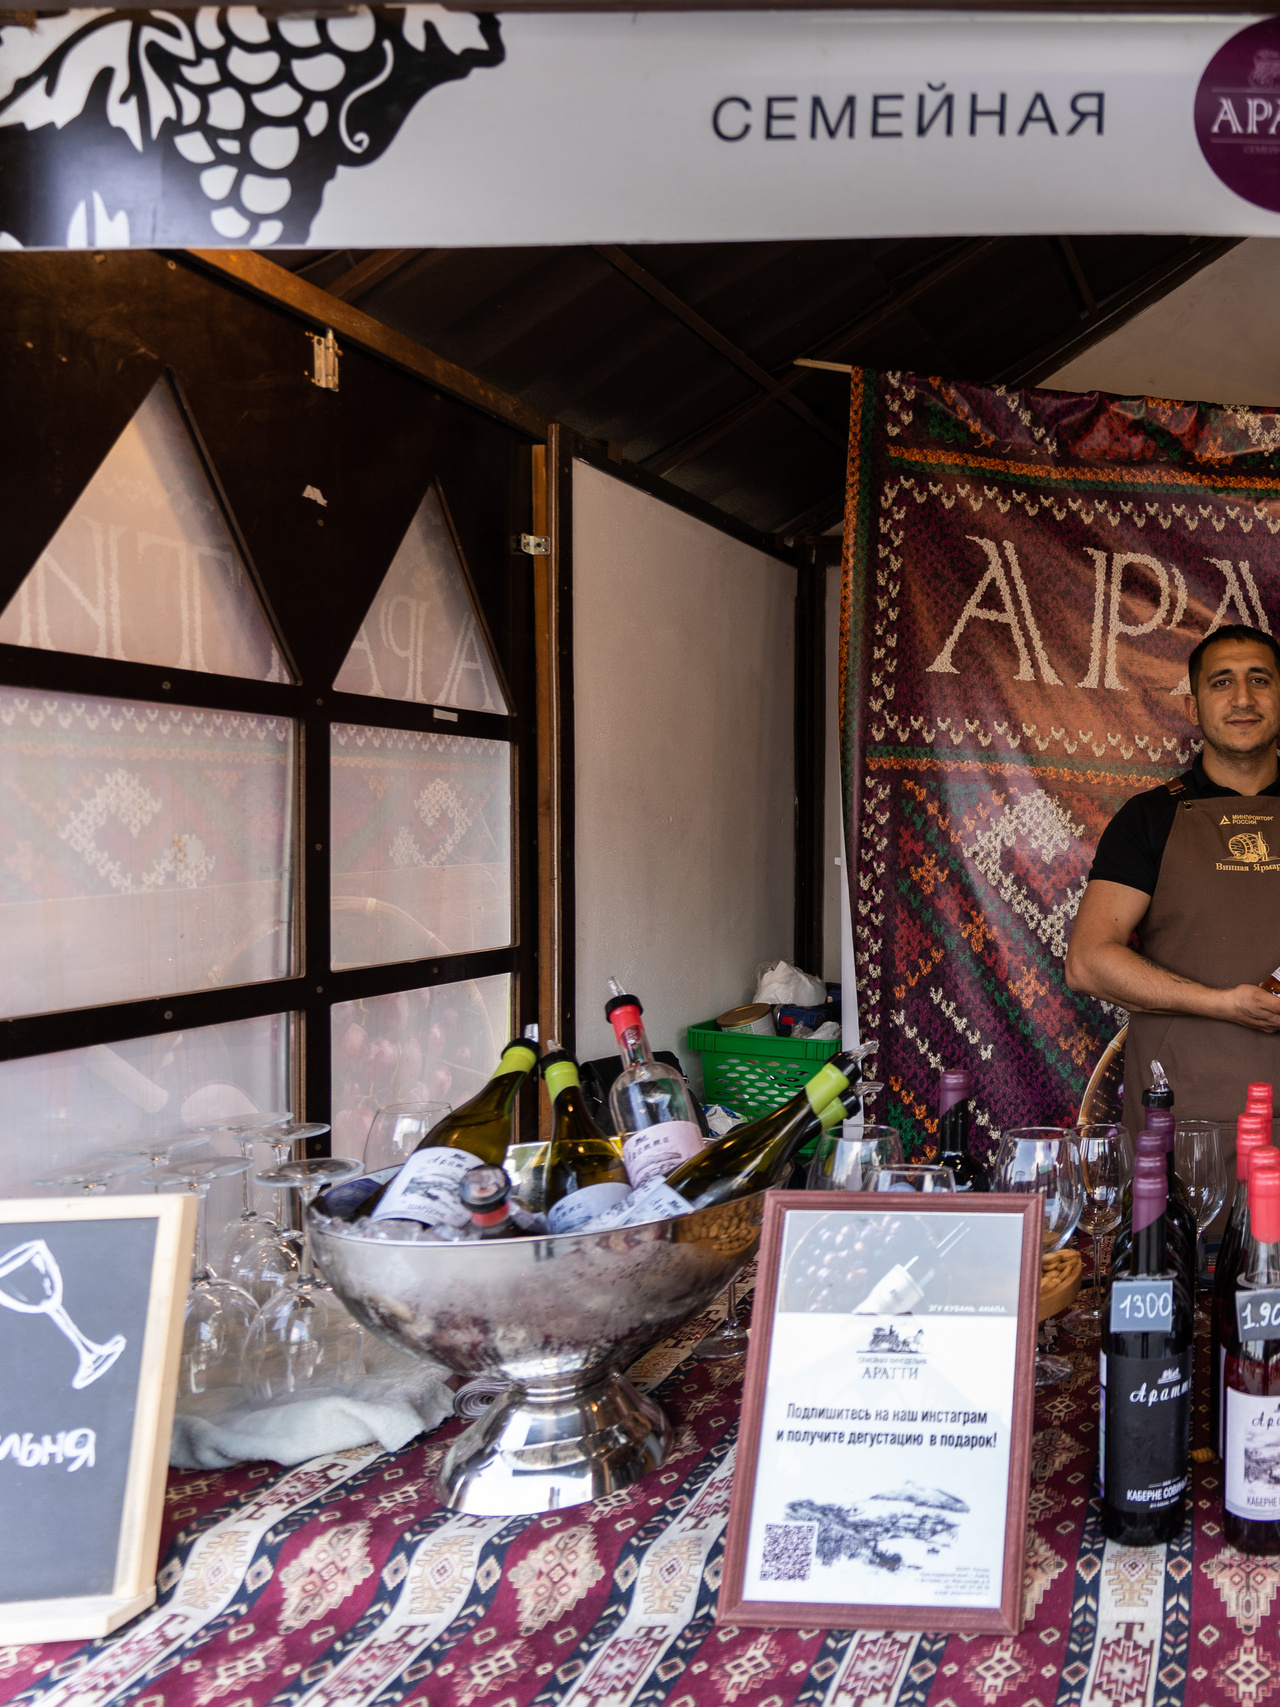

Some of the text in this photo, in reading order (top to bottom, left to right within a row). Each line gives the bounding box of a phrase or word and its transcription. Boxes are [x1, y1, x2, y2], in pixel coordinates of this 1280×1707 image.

[711, 82, 1109, 143] СЕМЕЙНАЯ
[1215, 862, 1249, 871] Винная
[1119, 1292, 1172, 1320] 1300
[861, 1366, 919, 1380] АРАТТИ
[786, 1403, 988, 1427] Подпишитесь на наш инстаграм
[776, 1429, 998, 1450] и получите дегустацию в подарок!
[1126, 1488, 1163, 1502] КАБЕРНЕ
